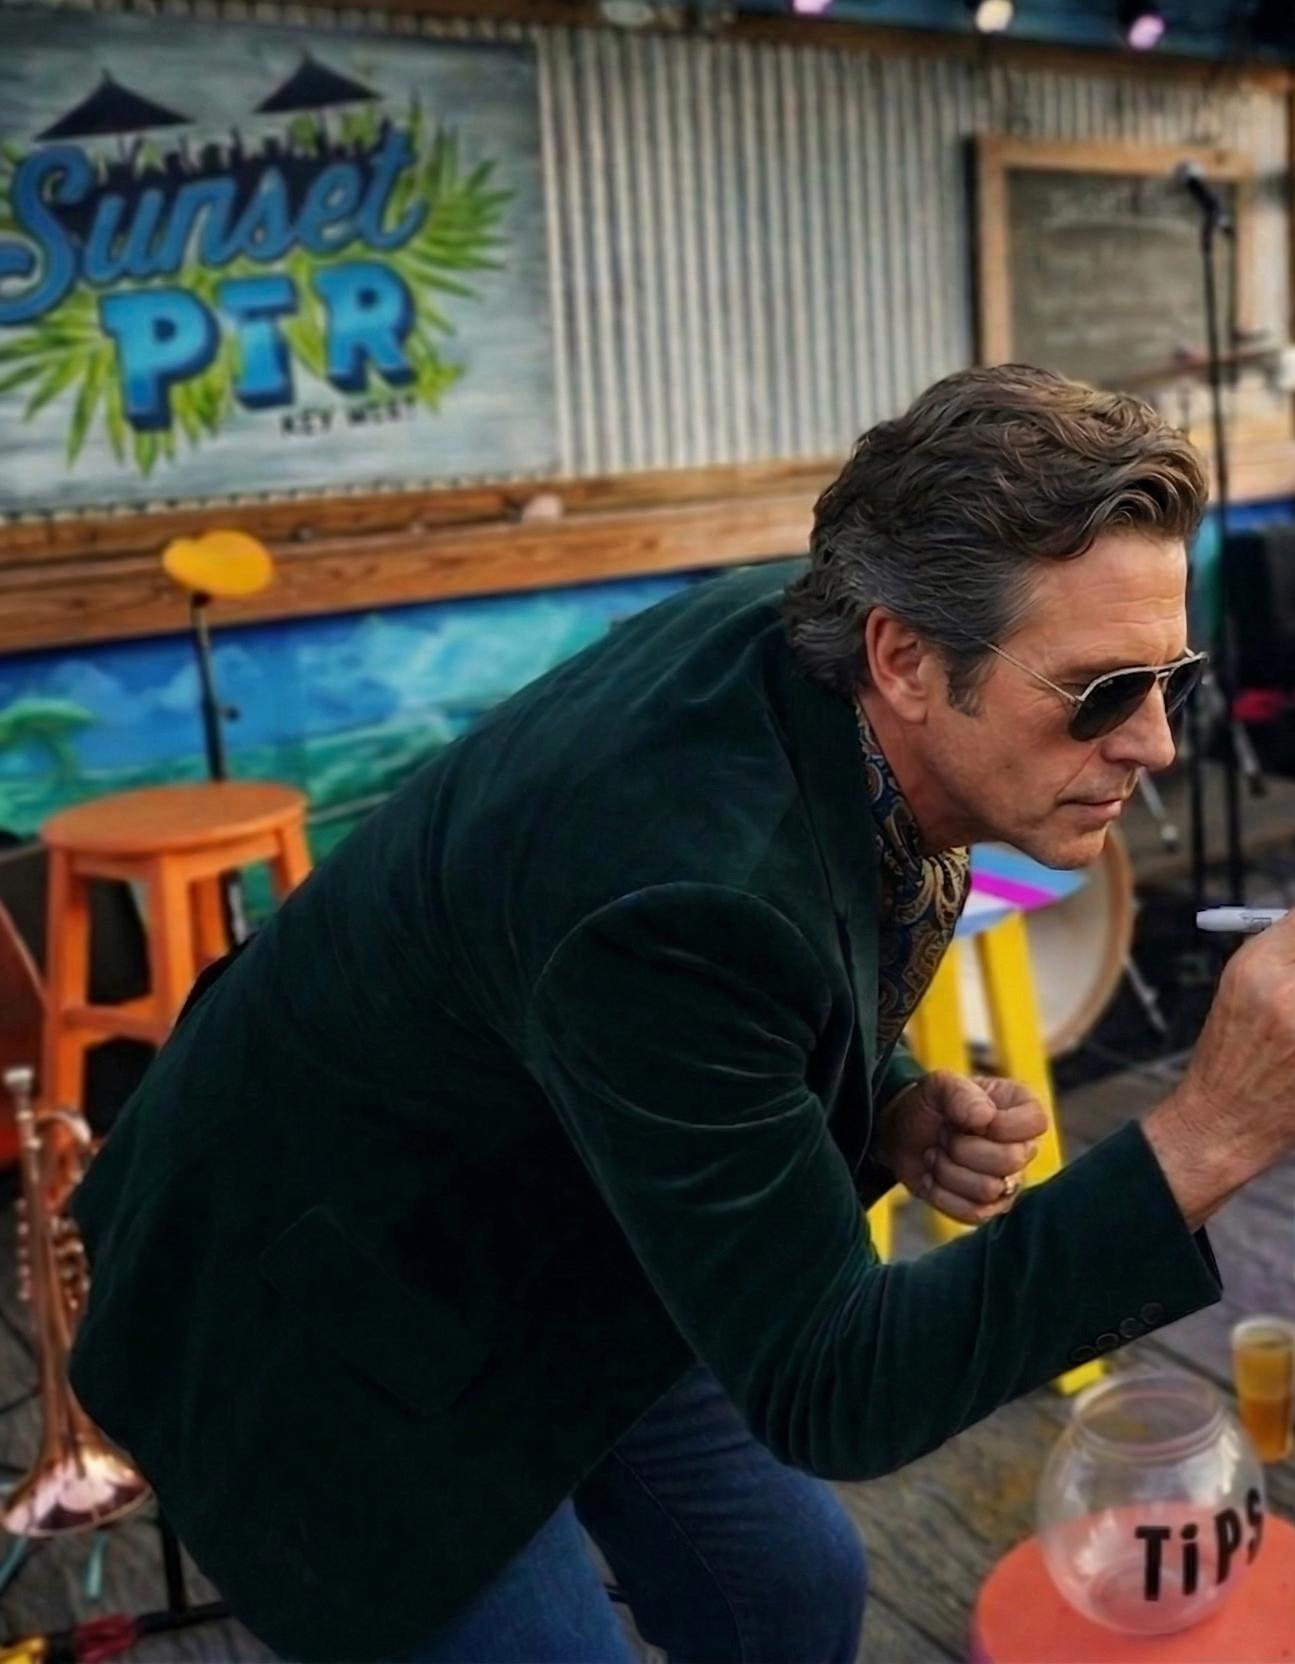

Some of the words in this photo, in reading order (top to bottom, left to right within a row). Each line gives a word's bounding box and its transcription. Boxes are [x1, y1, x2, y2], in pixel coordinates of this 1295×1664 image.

[0, 125, 428, 325] Sunset
[99, 260, 417, 432] PTR
[279, 406, 333, 437] KEY
